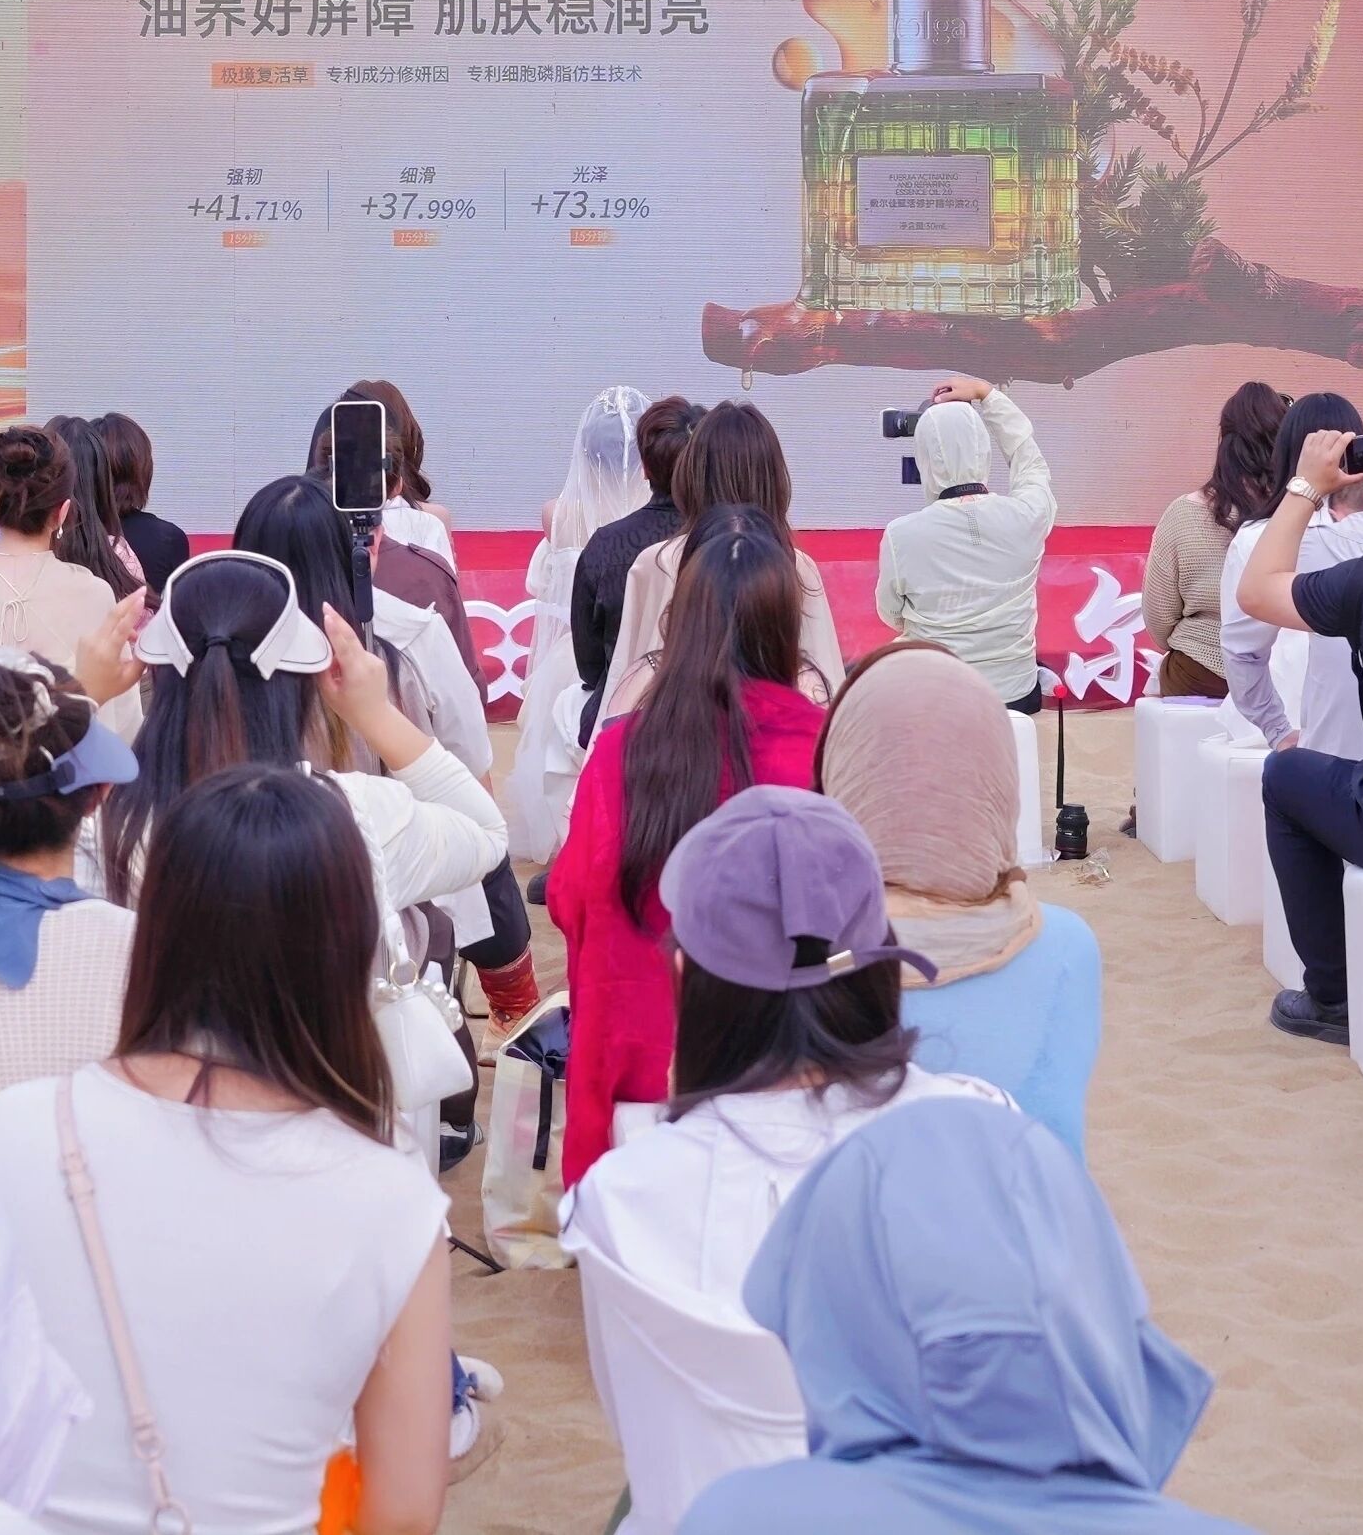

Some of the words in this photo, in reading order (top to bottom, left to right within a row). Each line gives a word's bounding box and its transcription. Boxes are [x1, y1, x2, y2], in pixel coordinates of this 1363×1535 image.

[467, 64, 643, 84] 专利细胞磷脂仿生技术
[226, 168, 264, 186] 强韧
[399, 166, 436, 184] 细滑
[572, 165, 608, 184] 光泽
[187, 194, 303, 221] +41.71%
[361, 192, 476, 220] +37.99%
[531, 190, 650, 219] +73.19%
